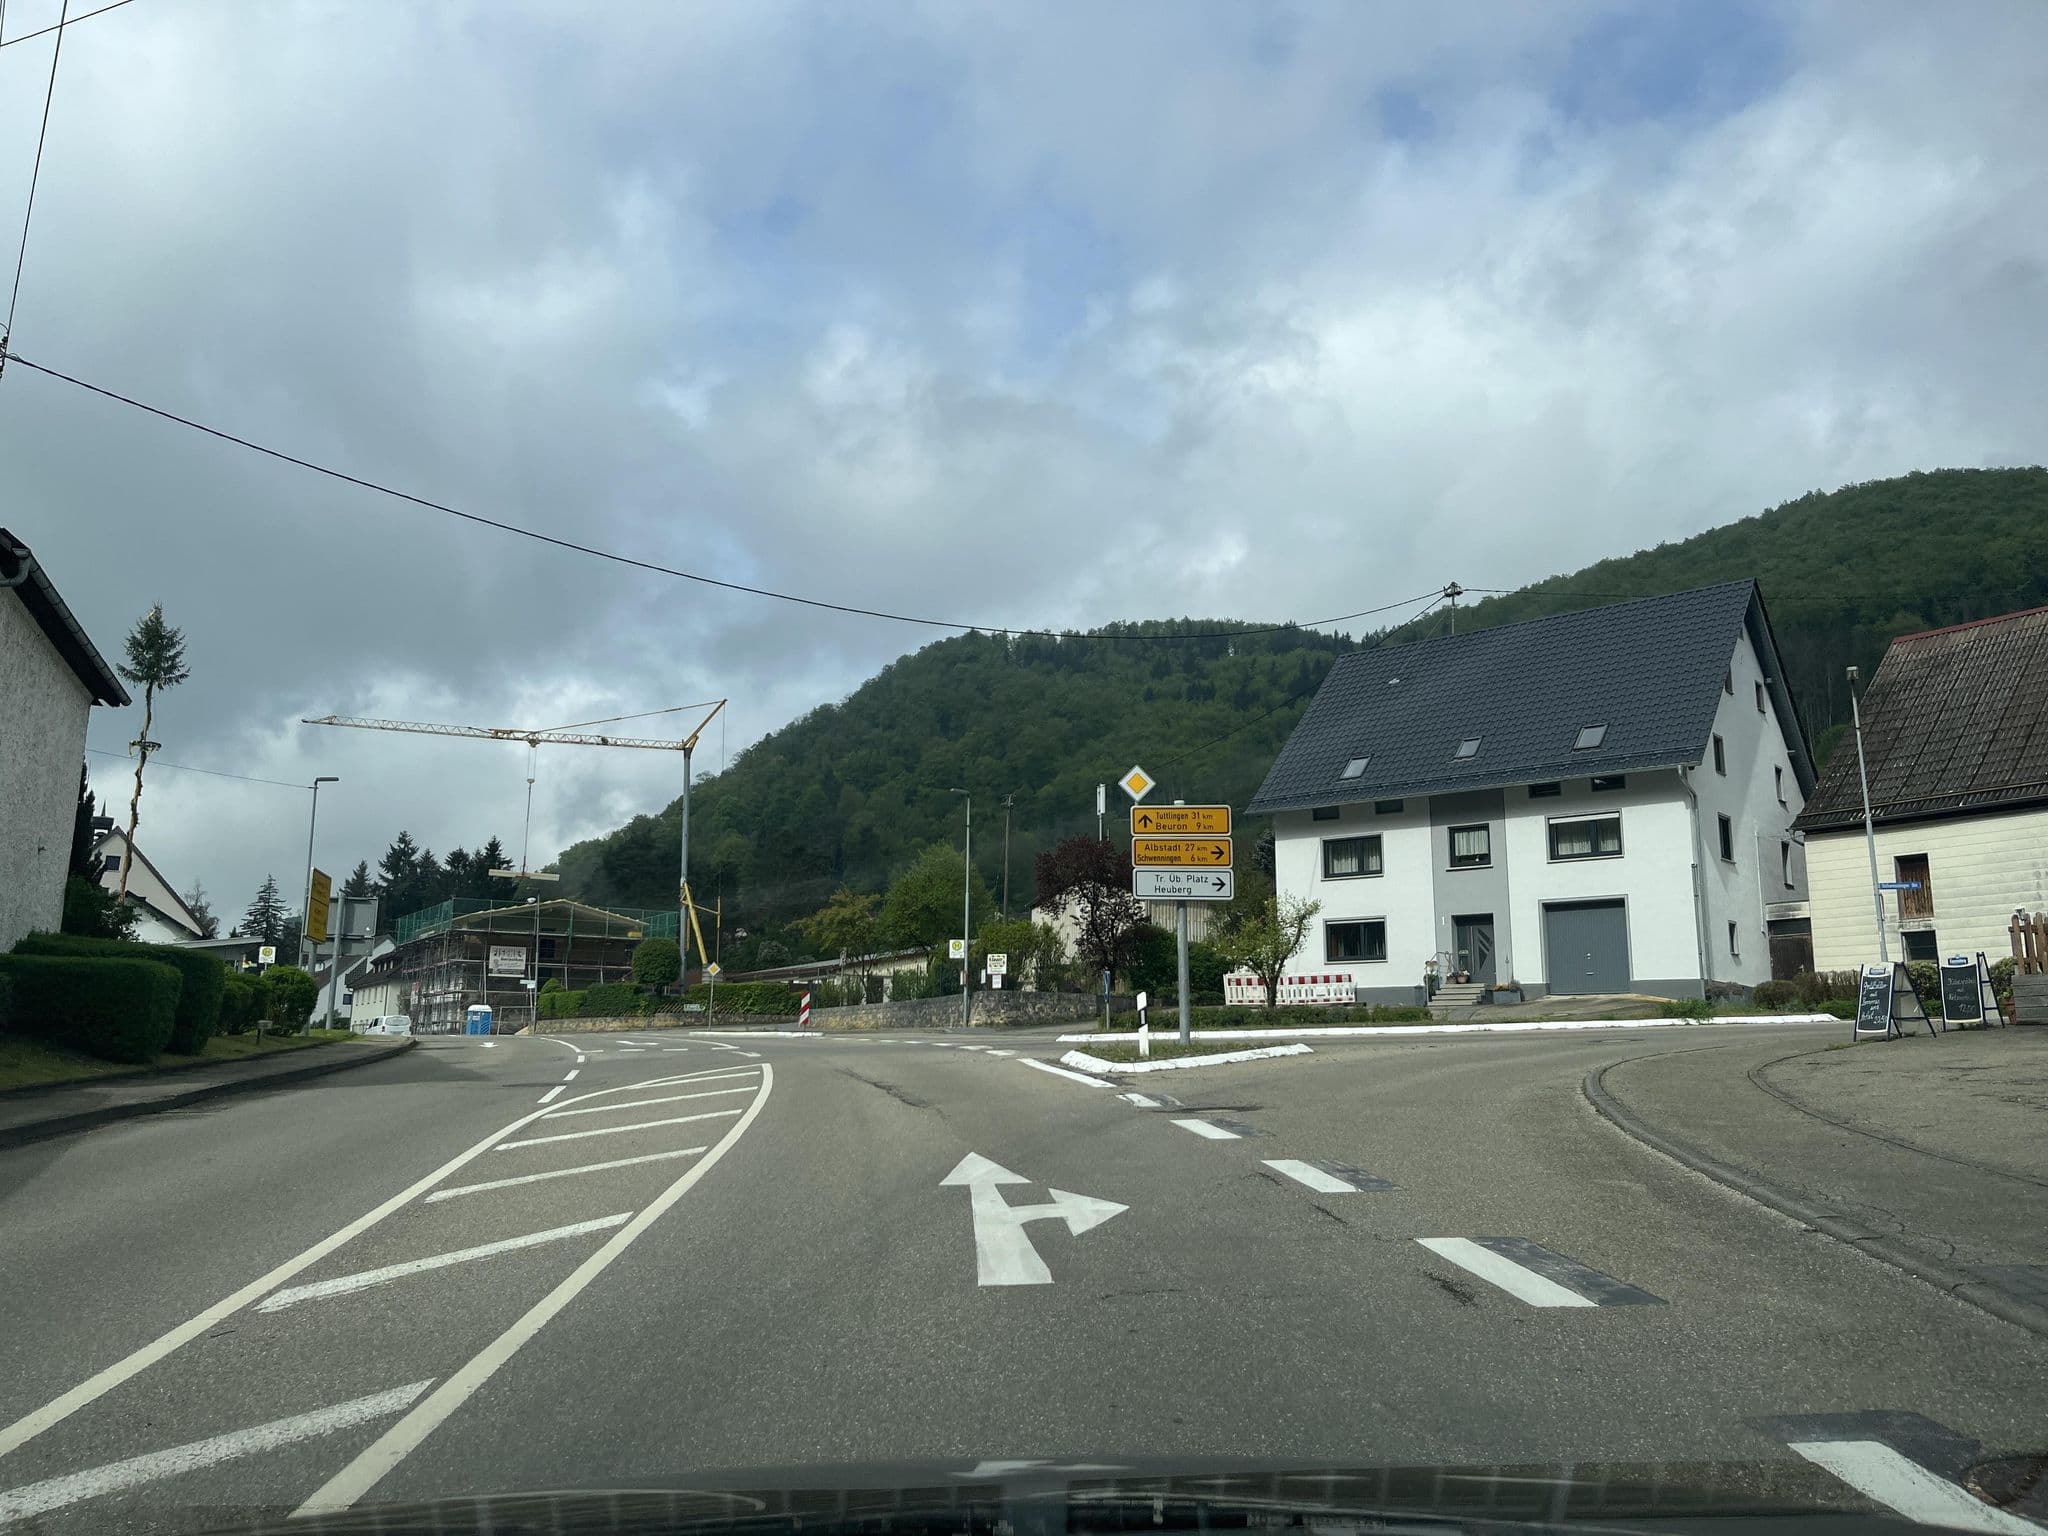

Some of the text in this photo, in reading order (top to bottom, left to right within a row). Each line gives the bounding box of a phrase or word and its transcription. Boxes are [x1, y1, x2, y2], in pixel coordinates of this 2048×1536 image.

[1156, 811, 1188, 821] Tuttlingen
[1192, 811, 1200, 820] 31
[1155, 822, 1188, 831] Beuron
[1196, 821, 1201, 831] 9
[1144, 843, 1181, 852] Albstadt
[1185, 843, 1195, 852] 27
[1137, 854, 1182, 864] Schwenningen
[1186, 874, 1209, 884] Platz
[1154, 885, 1192, 895] Heuberg
